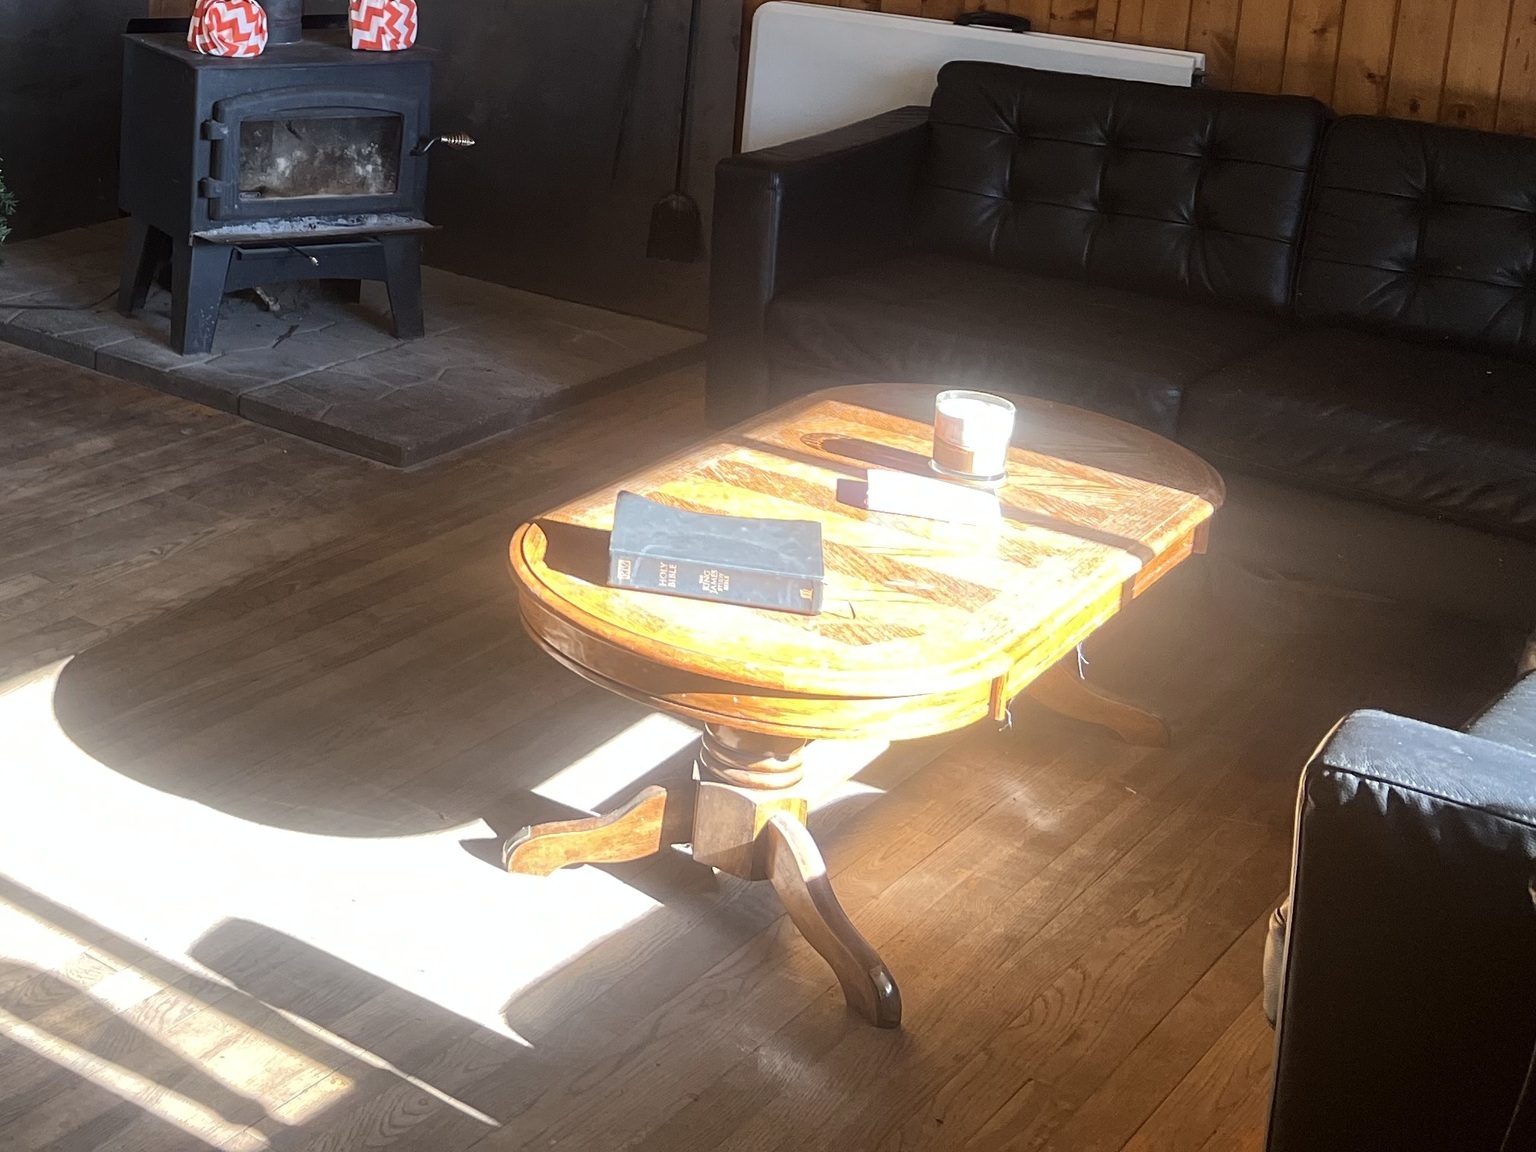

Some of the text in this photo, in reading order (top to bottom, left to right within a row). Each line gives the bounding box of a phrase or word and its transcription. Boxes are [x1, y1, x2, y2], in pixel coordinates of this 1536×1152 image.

[658, 561, 668, 587] HOLY
[667, 564, 677, 588] BIBLE
[702, 569, 711, 591] KING
[709, 569, 719, 595] JAMES
